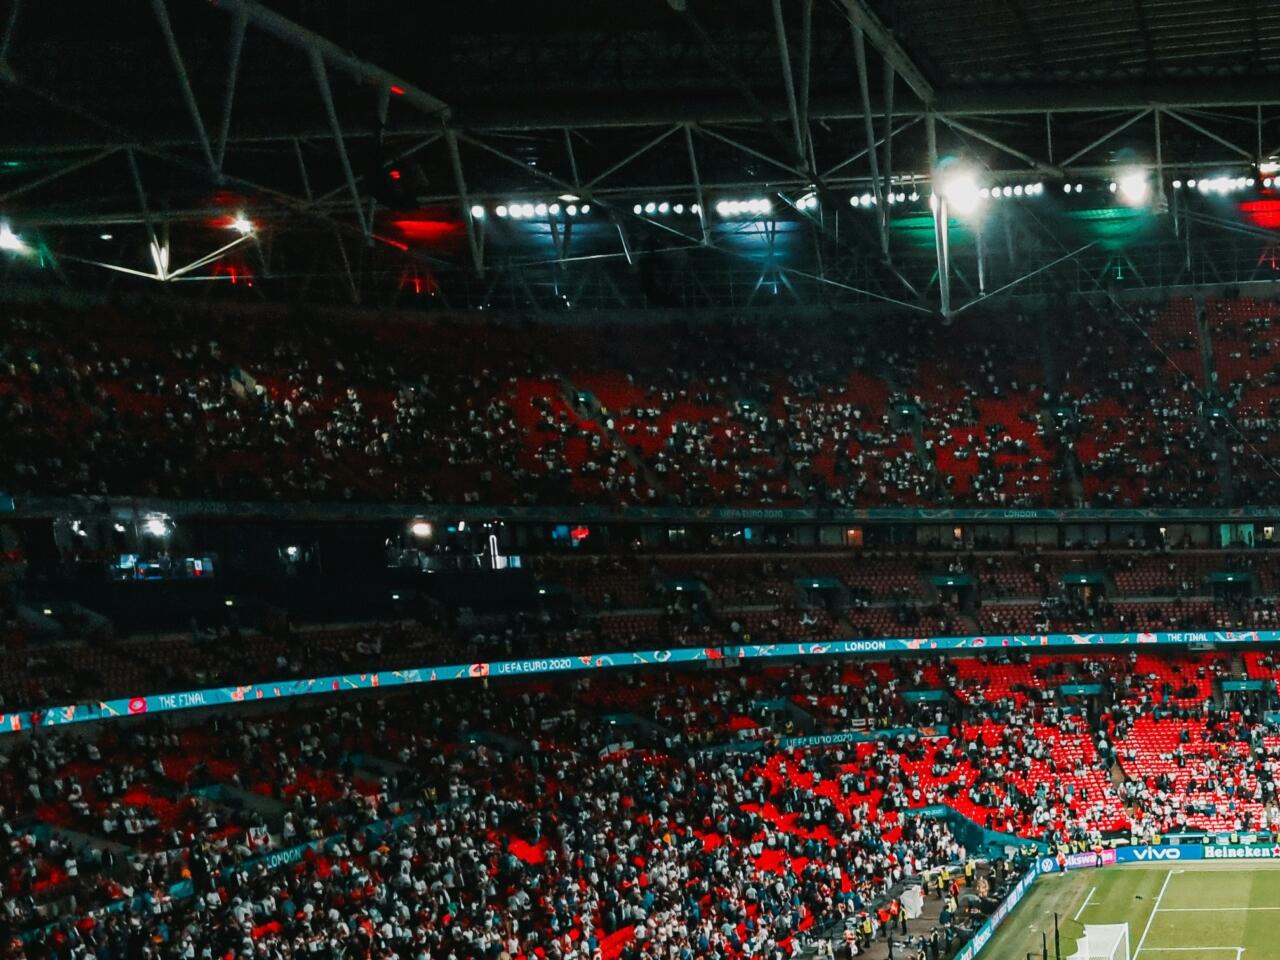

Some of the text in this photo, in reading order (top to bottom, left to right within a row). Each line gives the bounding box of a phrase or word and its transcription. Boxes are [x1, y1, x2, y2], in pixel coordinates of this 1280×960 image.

[844, 641, 886, 651] LONDON
[498, 658, 571, 673] UEFA EURO 2020
[159, 692, 206, 708] THE FINAL
[1205, 846, 1270, 857] Heineken
